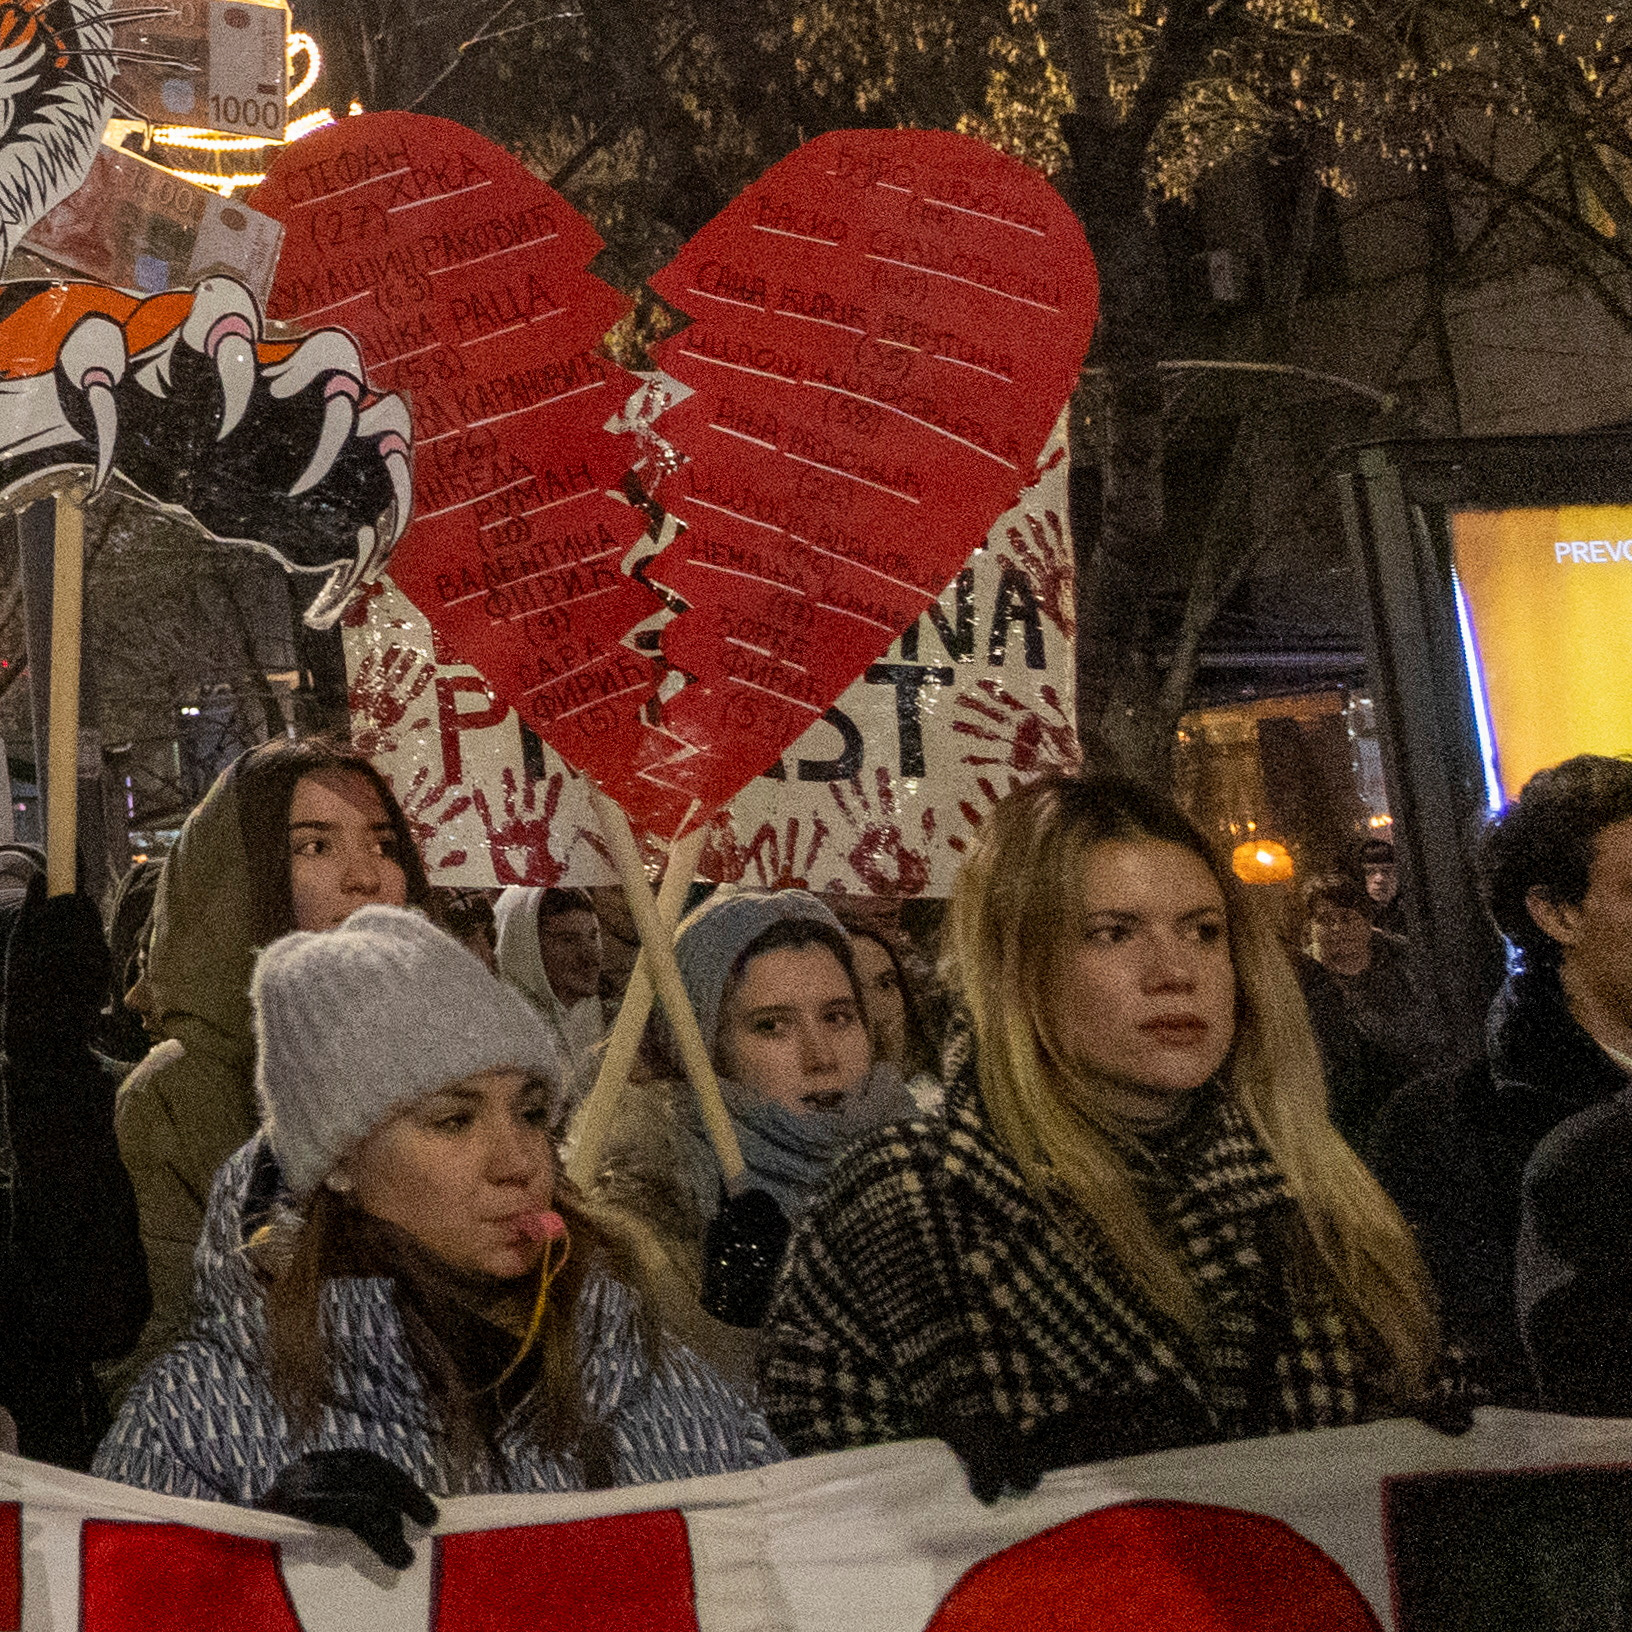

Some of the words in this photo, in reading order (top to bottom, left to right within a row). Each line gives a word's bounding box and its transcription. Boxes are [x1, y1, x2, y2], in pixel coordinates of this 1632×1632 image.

[209, 93, 282, 132] 1000
[282, 136, 412, 204] СТЕФАН
[387, 150, 489, 206] ХРКА
[310, 202, 391, 253] (27)
[448, 273, 559, 340] РАЦА
[473, 460, 598, 527] РУМАН
[434, 521, 620, 604] ВАЛЕНТИНА
[483, 558, 620, 624] ФИРИЋ
[516, 635, 605, 689] САРА
